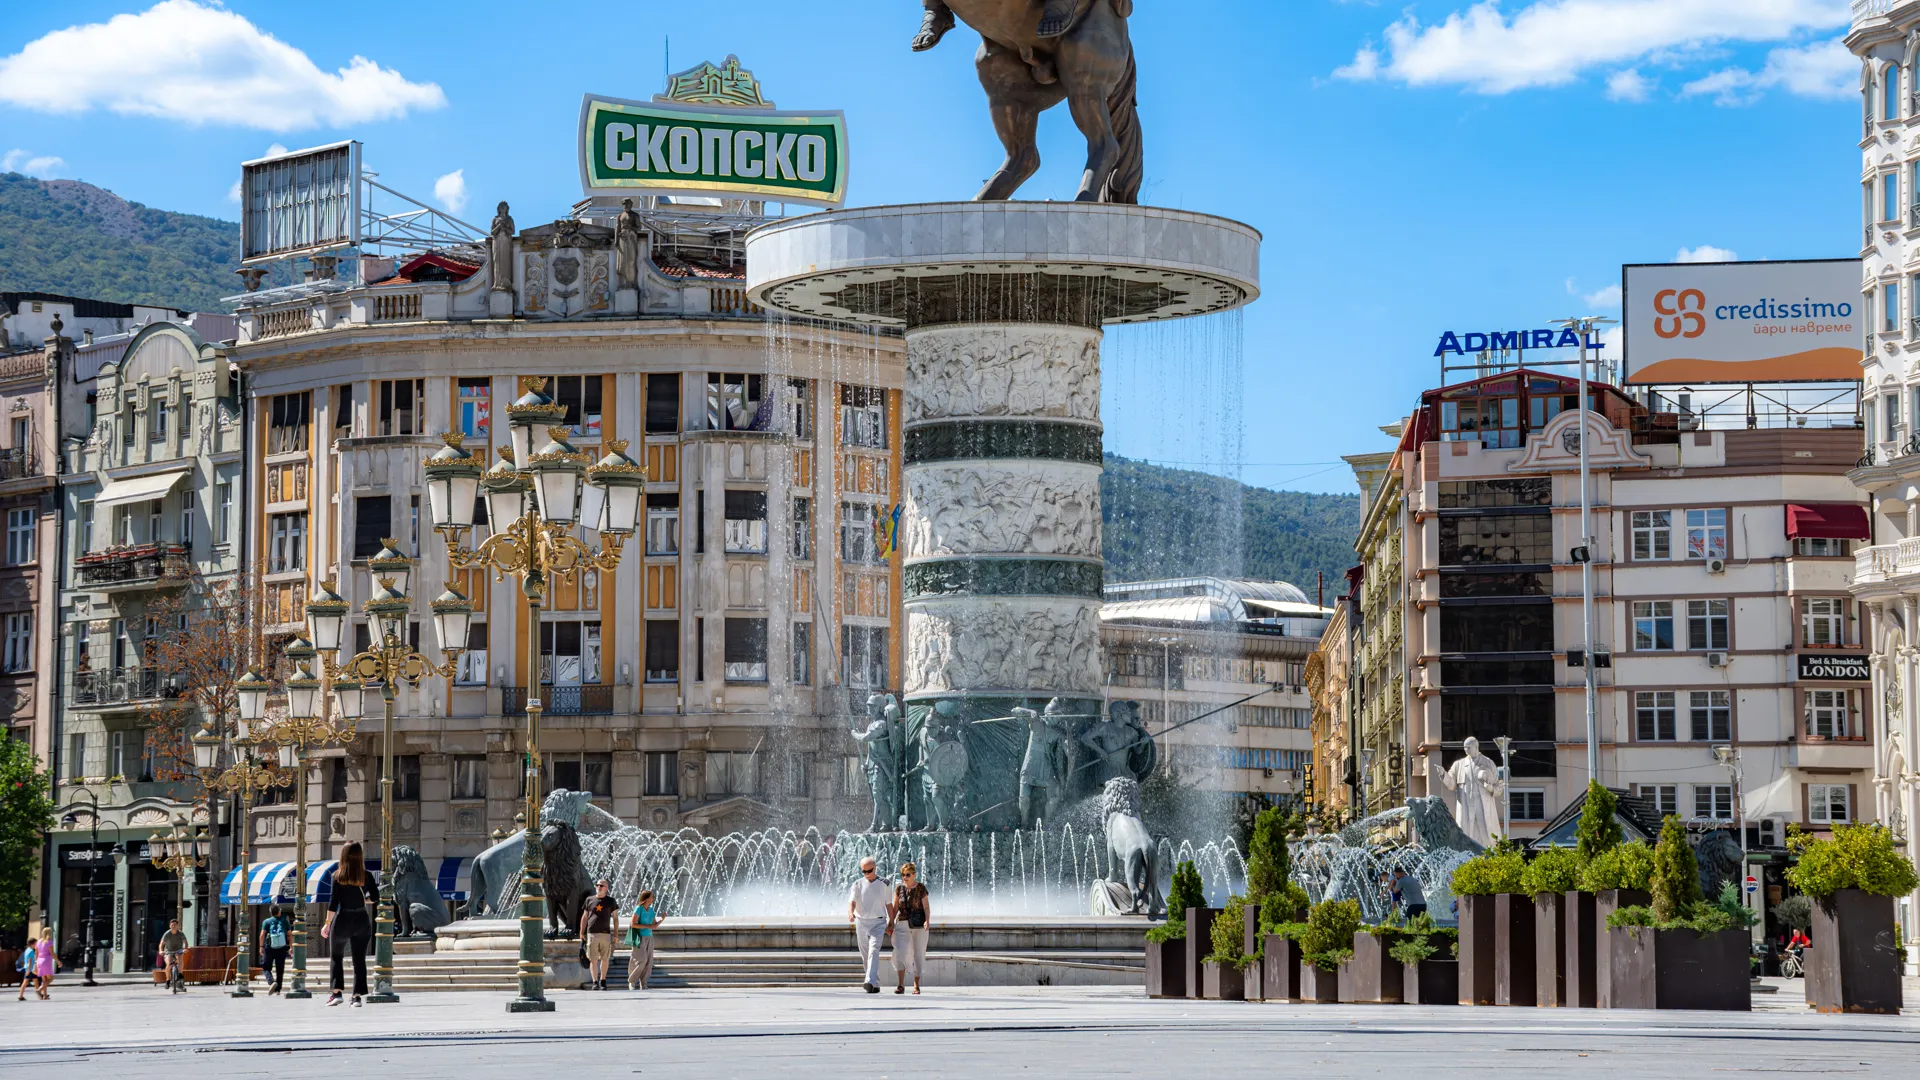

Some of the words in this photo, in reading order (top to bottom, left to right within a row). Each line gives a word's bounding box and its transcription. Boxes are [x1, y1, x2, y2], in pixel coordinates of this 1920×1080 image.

[605, 122, 826, 182] СКОПСКО
[1715, 297, 1852, 320] credissimo
[1791, 321, 1852, 335] навреме
[1433, 325, 1606, 357] ADMIRAL
[1809, 657, 1822, 665] Bed
[1823, 657, 1831, 665] &
[1831, 657, 1863, 666] Breakfast
[1802, 665, 1869, 677] LONDON
